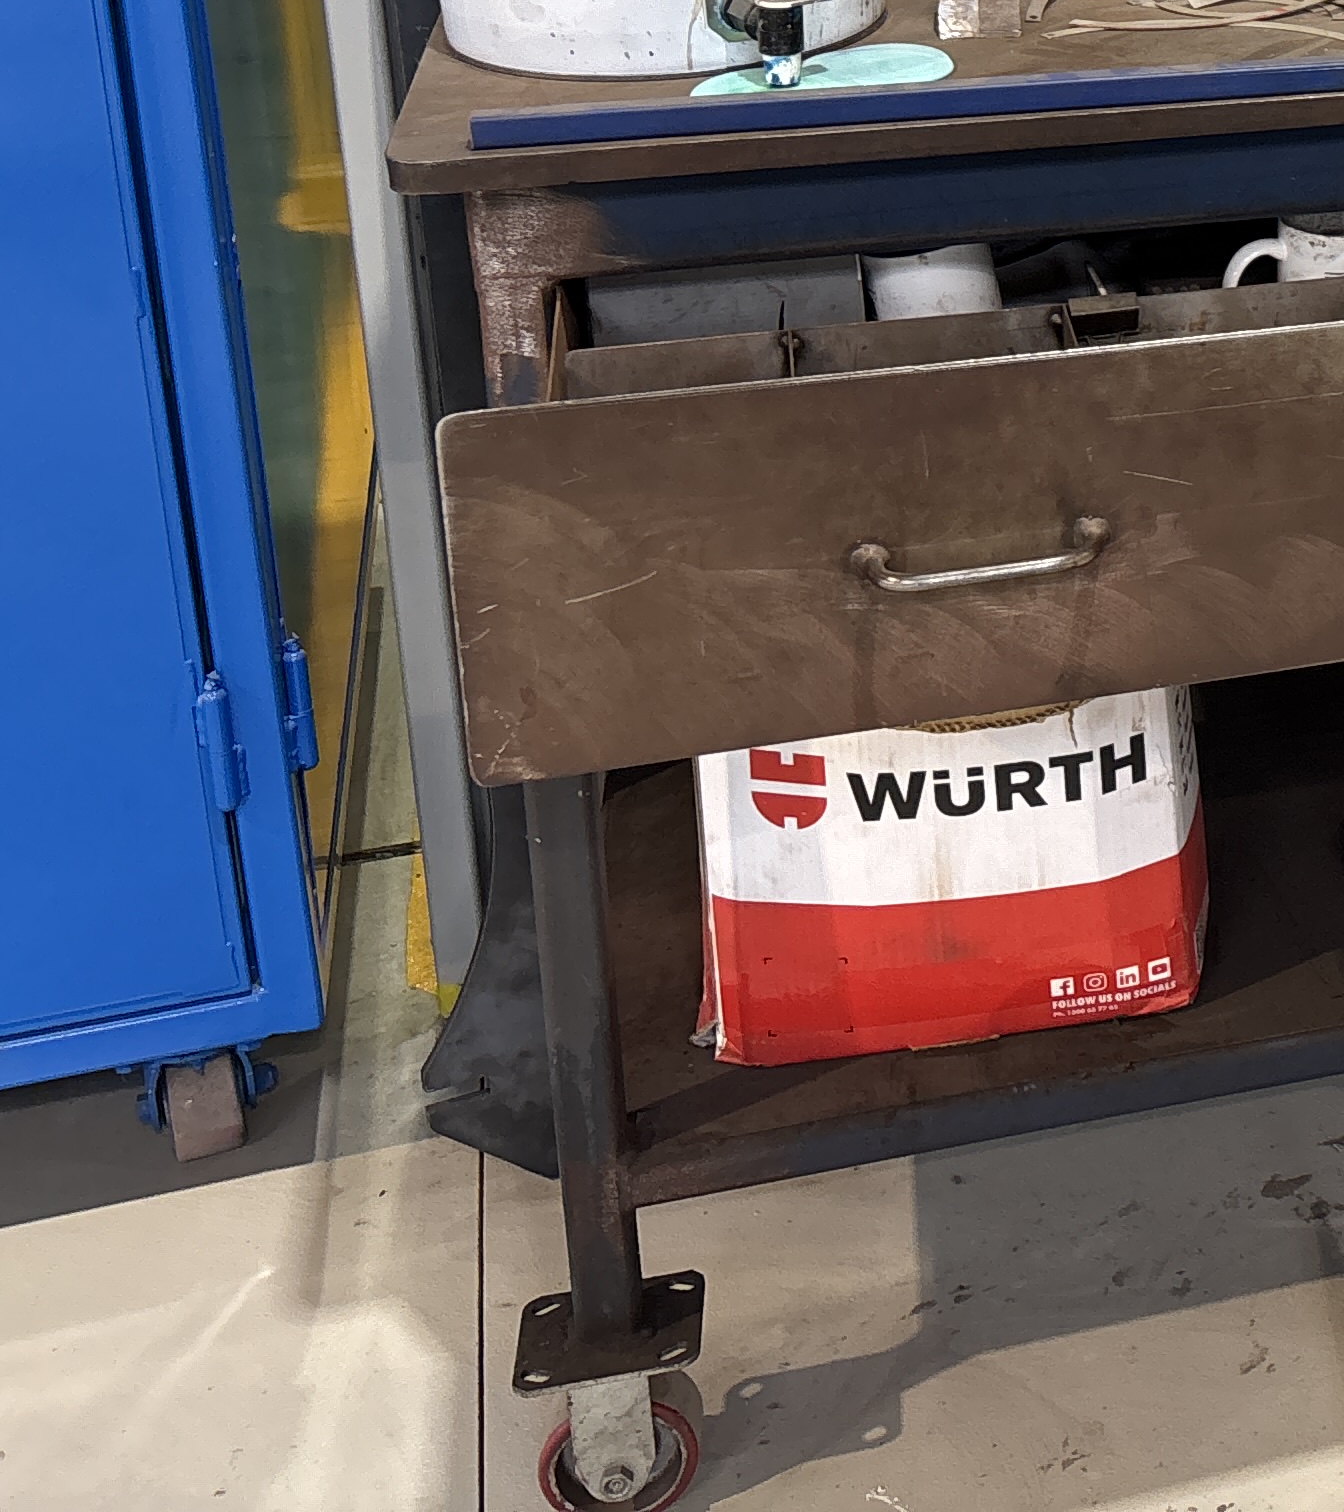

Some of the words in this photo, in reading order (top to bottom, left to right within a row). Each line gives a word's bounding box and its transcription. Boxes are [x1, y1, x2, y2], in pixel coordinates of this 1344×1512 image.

[1052, 995, 1096, 1009] FOLLOW
[1098, 993, 1112, 1003] US
[1115, 991, 1131, 1002] ON
[1133, 980, 1177, 999] SOCIALS
